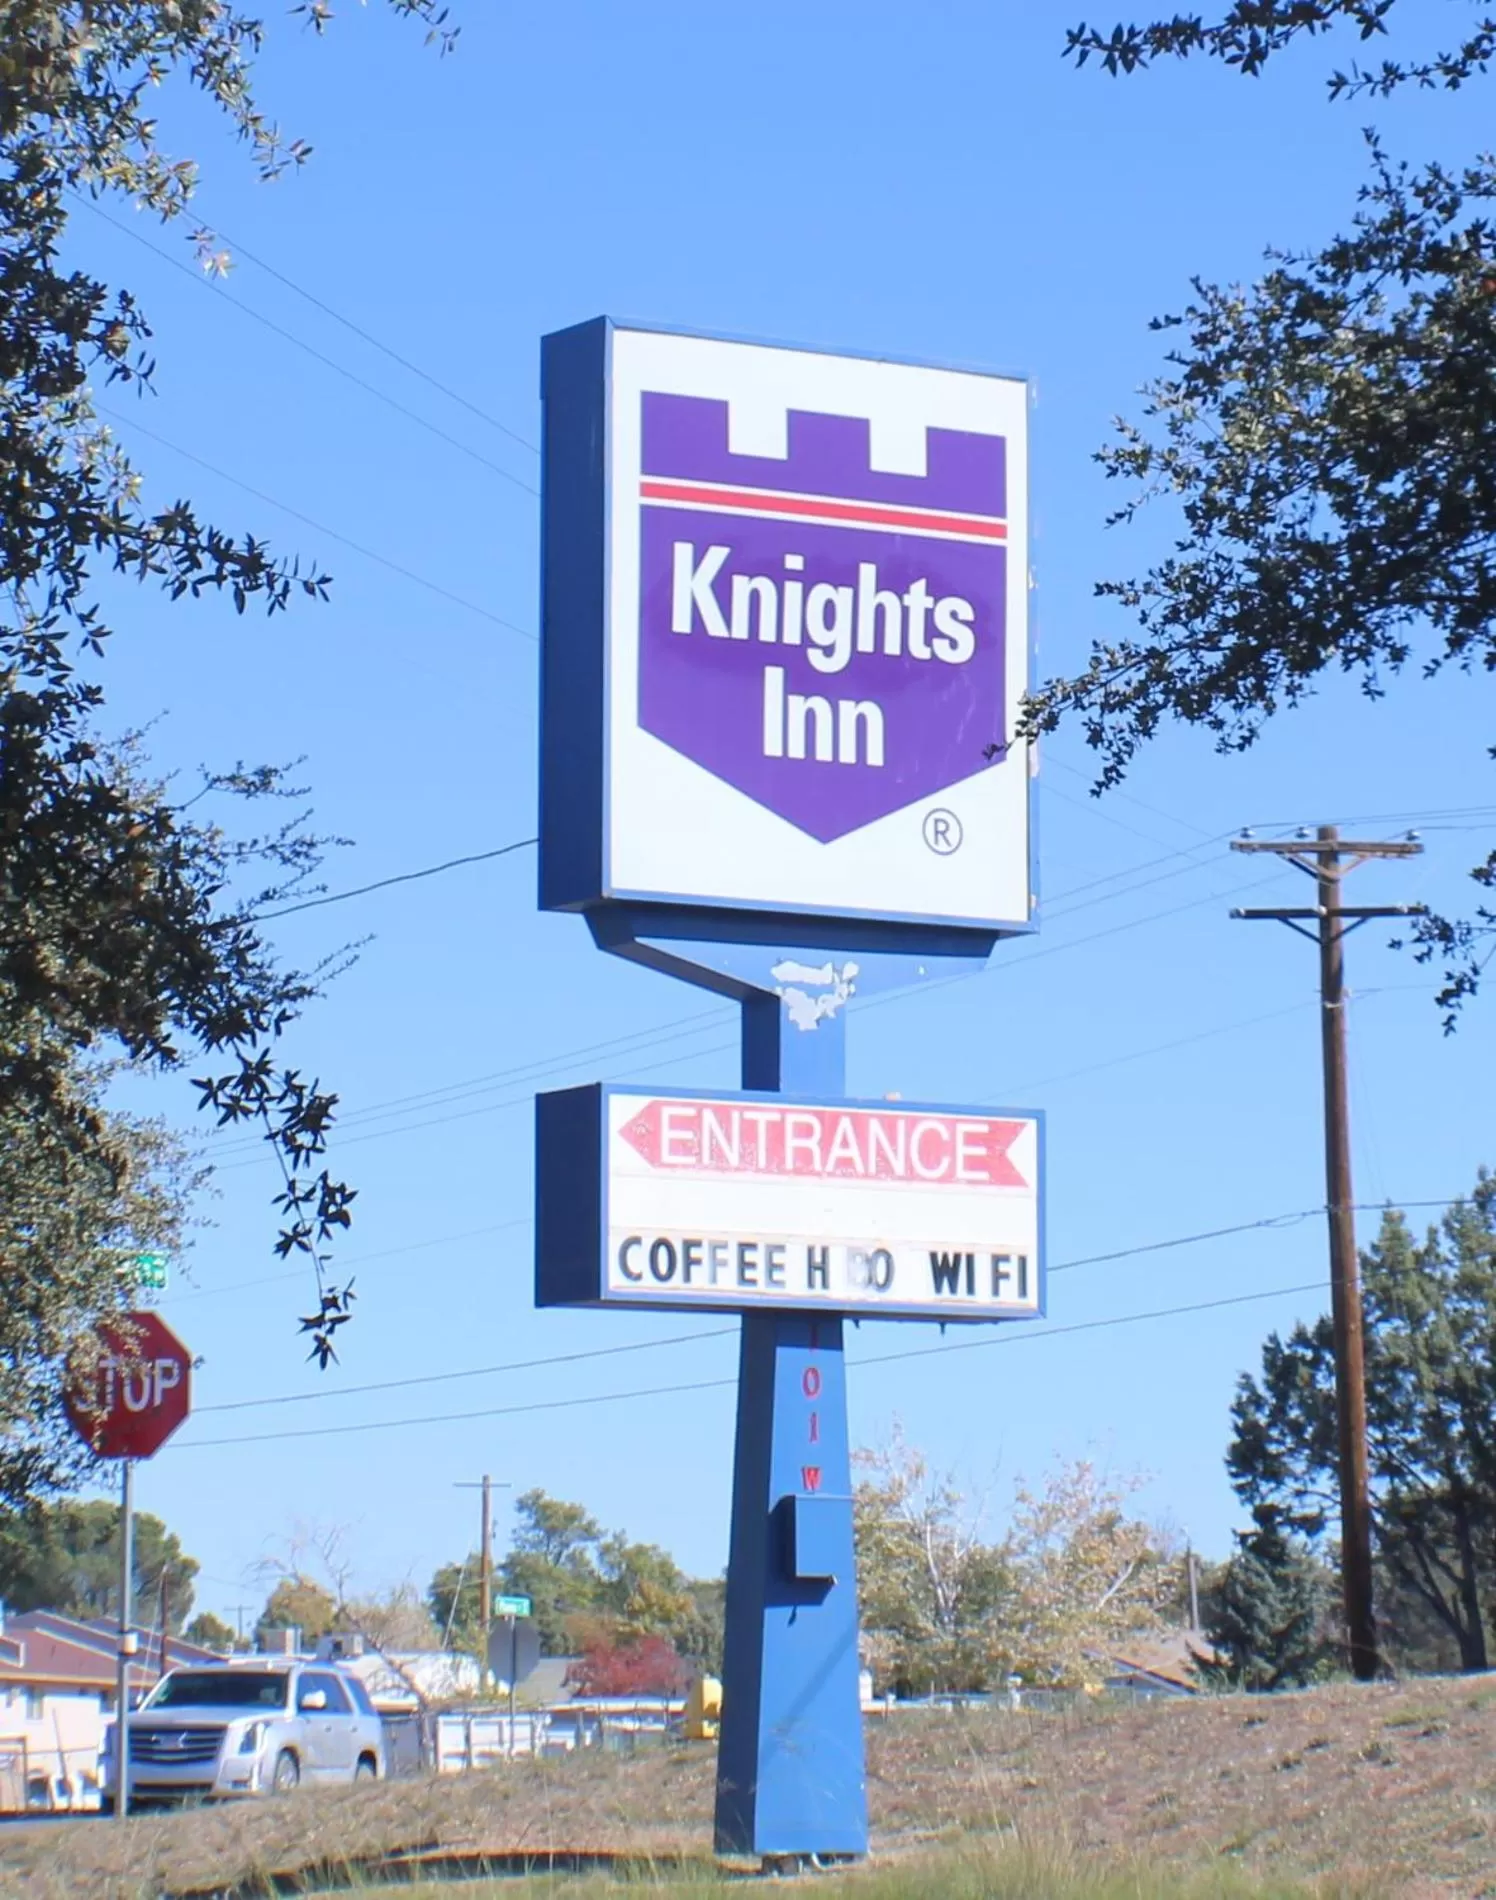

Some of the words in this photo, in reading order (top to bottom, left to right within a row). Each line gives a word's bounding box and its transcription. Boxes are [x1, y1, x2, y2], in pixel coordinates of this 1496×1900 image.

[671, 541, 976, 674] Knights
[763, 665, 885, 768] Inn
[660, 1105, 991, 1182] ENTRANCE
[618, 1235, 787, 1290] COFFEE
